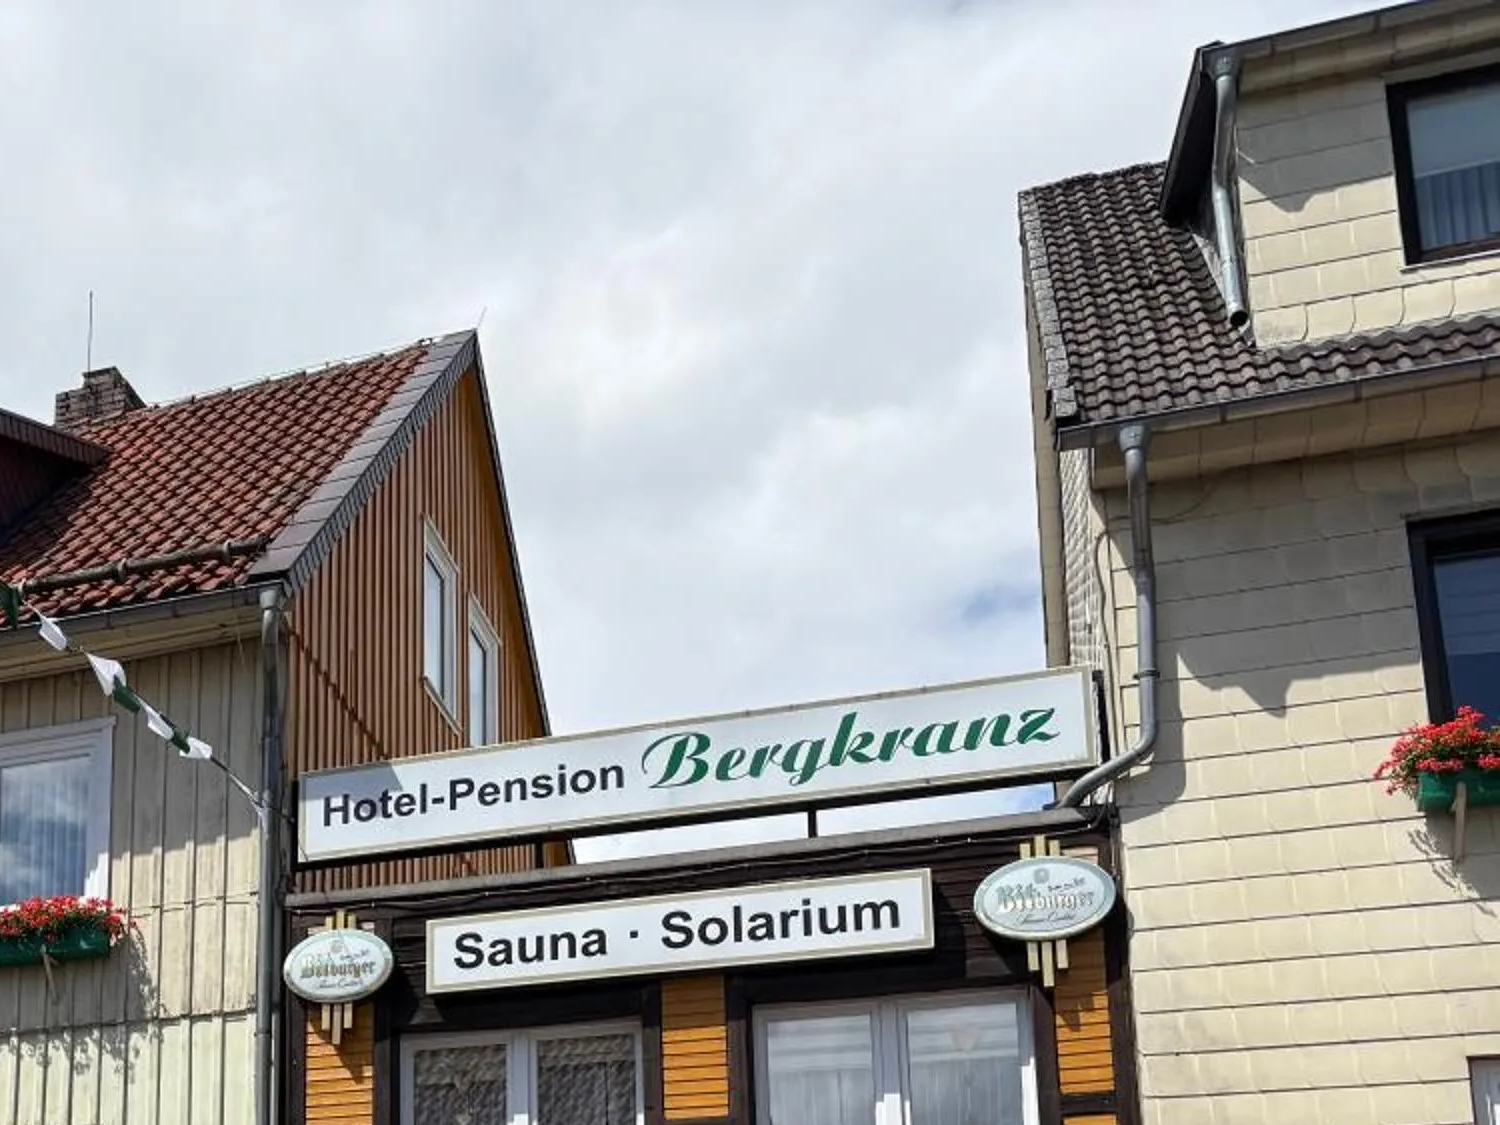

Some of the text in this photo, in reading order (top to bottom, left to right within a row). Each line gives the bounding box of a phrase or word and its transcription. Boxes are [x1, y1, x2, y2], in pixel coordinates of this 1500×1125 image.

[322, 707, 1061, 828] Hotel-Pension Bergkranz
[452, 928, 608, 970] Sauna
[661, 897, 901, 950] Solarium
